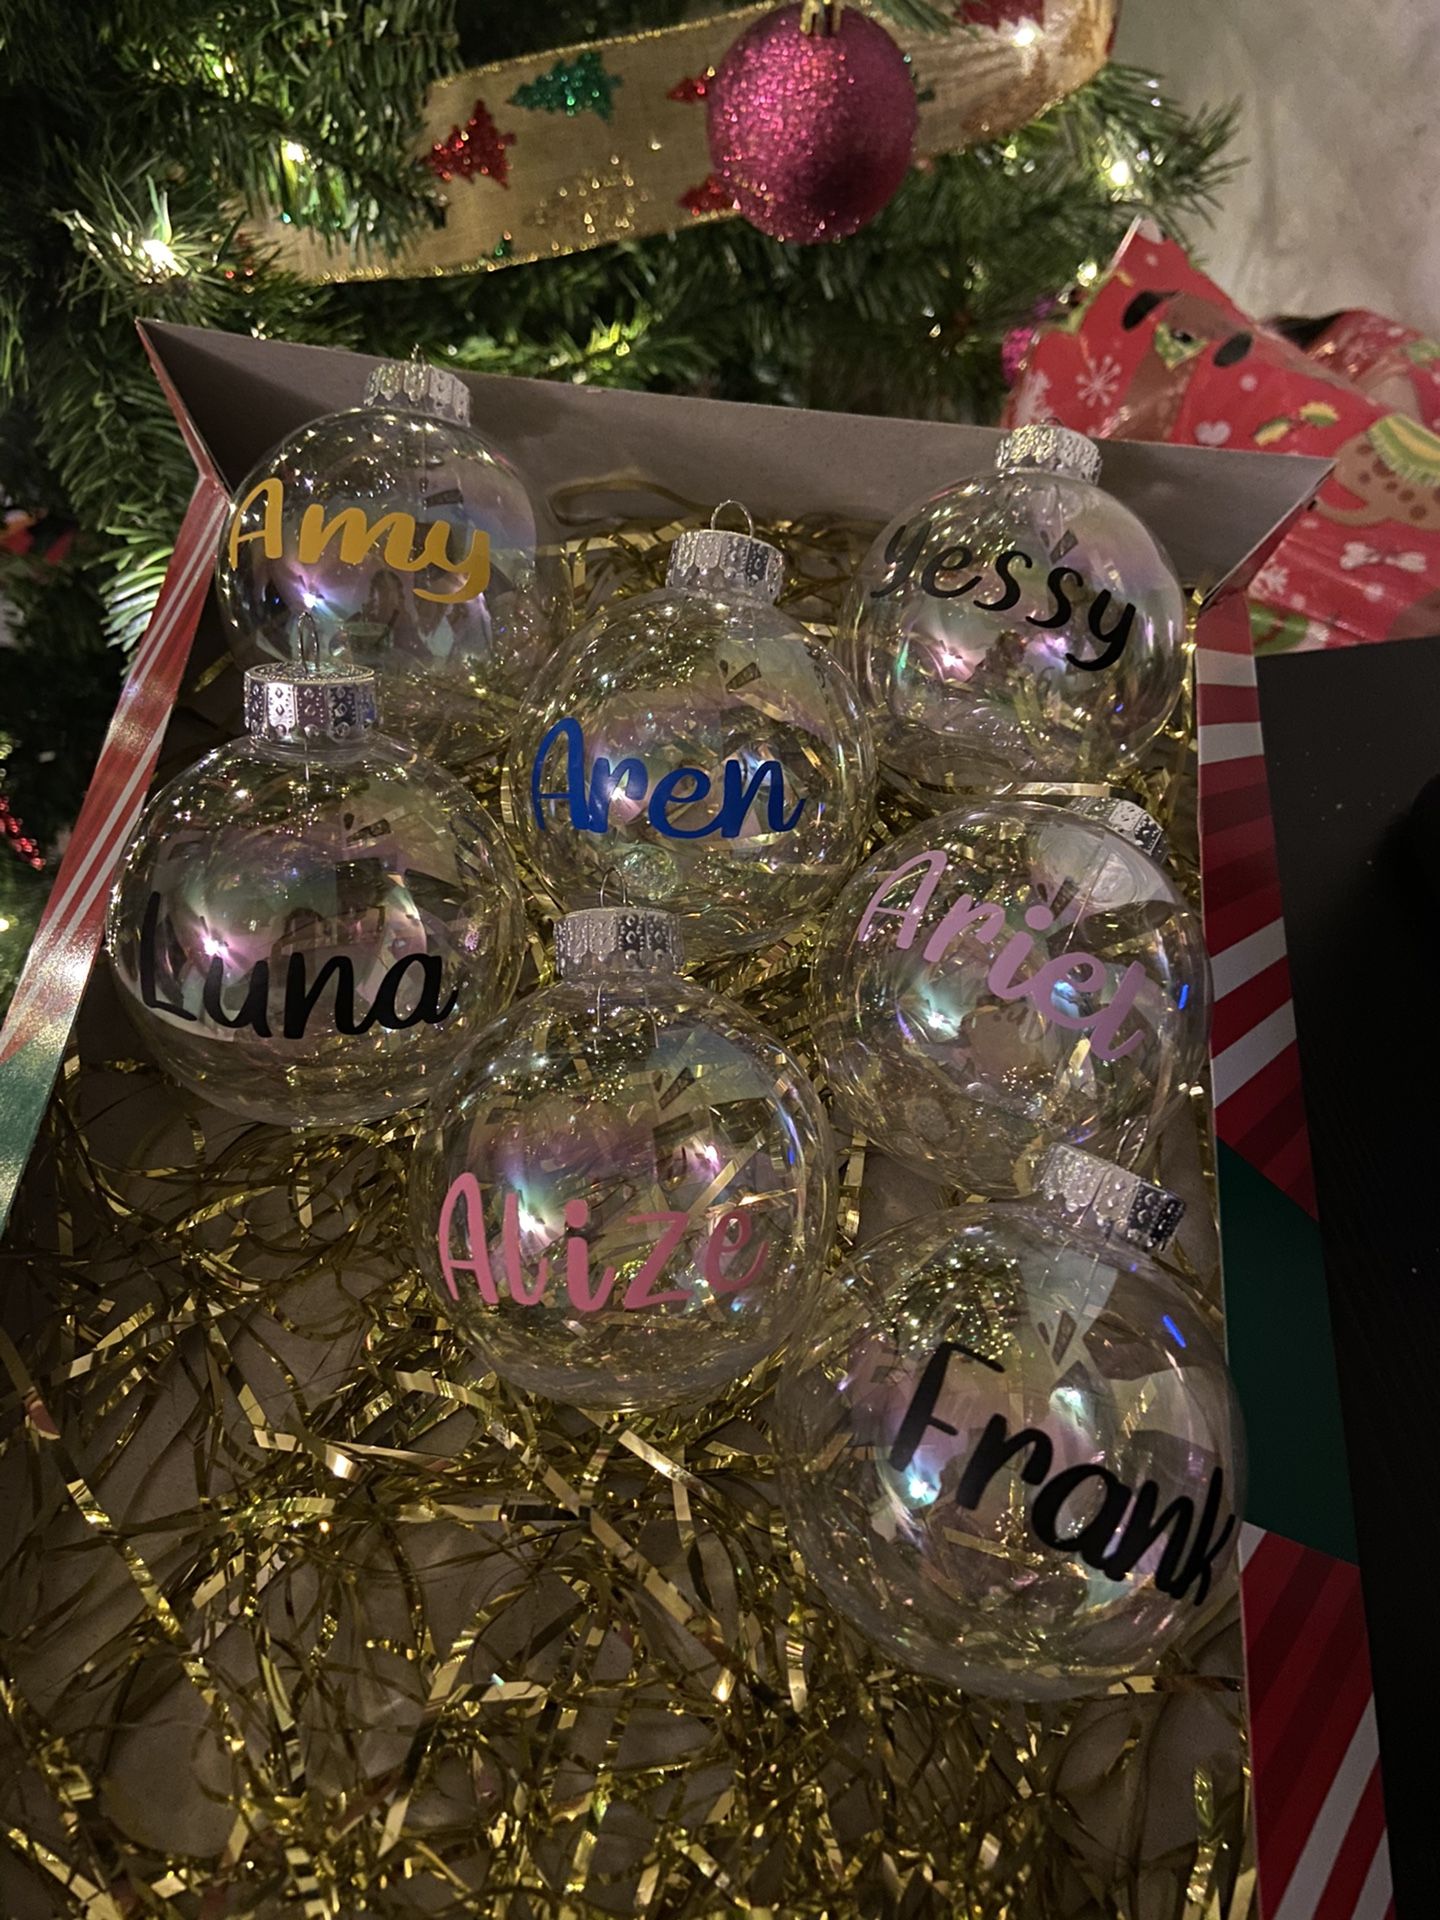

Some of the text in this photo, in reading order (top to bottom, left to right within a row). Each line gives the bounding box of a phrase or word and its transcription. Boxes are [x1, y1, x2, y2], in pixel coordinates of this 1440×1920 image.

[229, 477, 491, 604] Amy
[531, 717, 806, 839] Aren
[140, 890, 459, 1039] Luna
[858, 850, 1145, 1060] Ariel
[438, 1172, 769, 1312] Alize
[889, 1342, 1236, 1606] Frank
